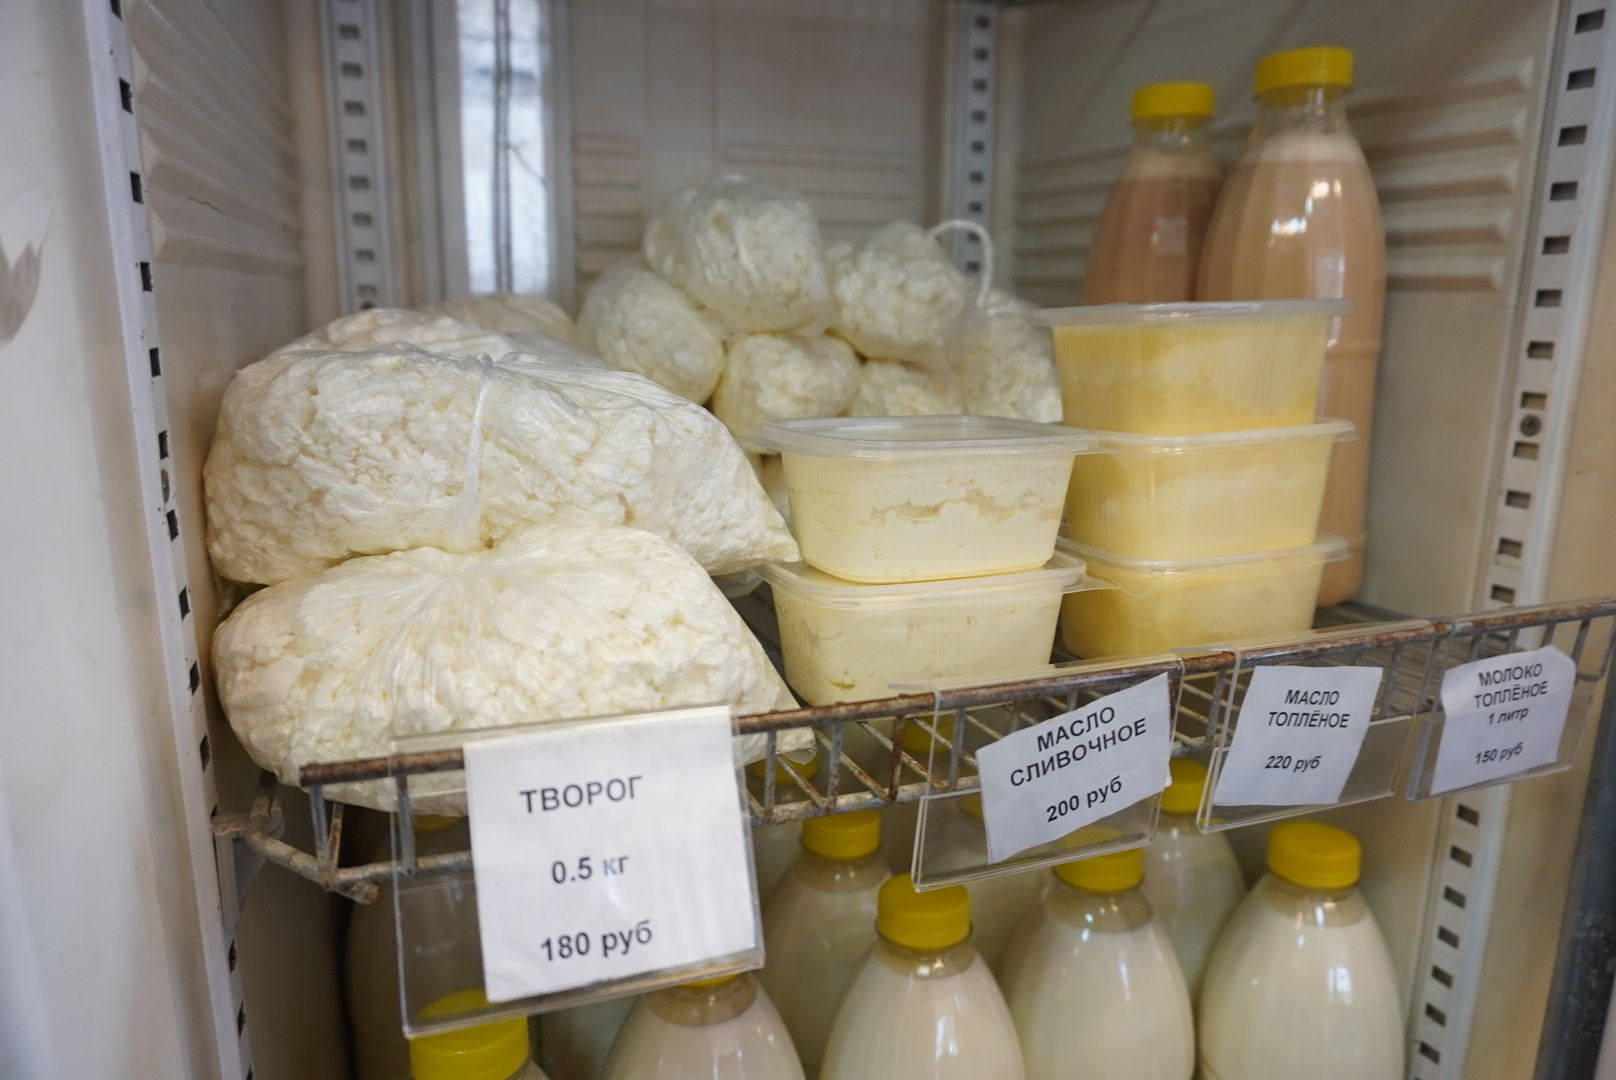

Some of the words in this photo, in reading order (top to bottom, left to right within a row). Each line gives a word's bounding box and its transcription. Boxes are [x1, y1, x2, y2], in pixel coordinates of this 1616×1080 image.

[1478, 664, 1543, 686] МОЛОКО
[1284, 690, 1339, 705] МАСЛО
[1475, 681, 1548, 708] ТОПЛЁНОЕ
[1037, 707, 1115, 752] МАСЛО
[1268, 710, 1350, 728] ТОПЛЁНОЕ
[1488, 713, 1494, 724] 1
[1497, 708, 1529, 724] литр
[1010, 718, 1147, 786] СЛИВОЧНОЕ
[1265, 756, 1292, 769] 220
[1293, 756, 1321, 772] руб
[1475, 749, 1497, 764] 150
[1499, 742, 1524, 762] руб
[520, 776, 643, 813] ТВОРОГ
[1046, 796, 1080, 822] 200
[1087, 776, 1122, 807] руб
[552, 858, 593, 884] 0.5
[603, 857, 628, 876] кг
[540, 932, 590, 961] 180
[602, 920, 652, 957] руб
